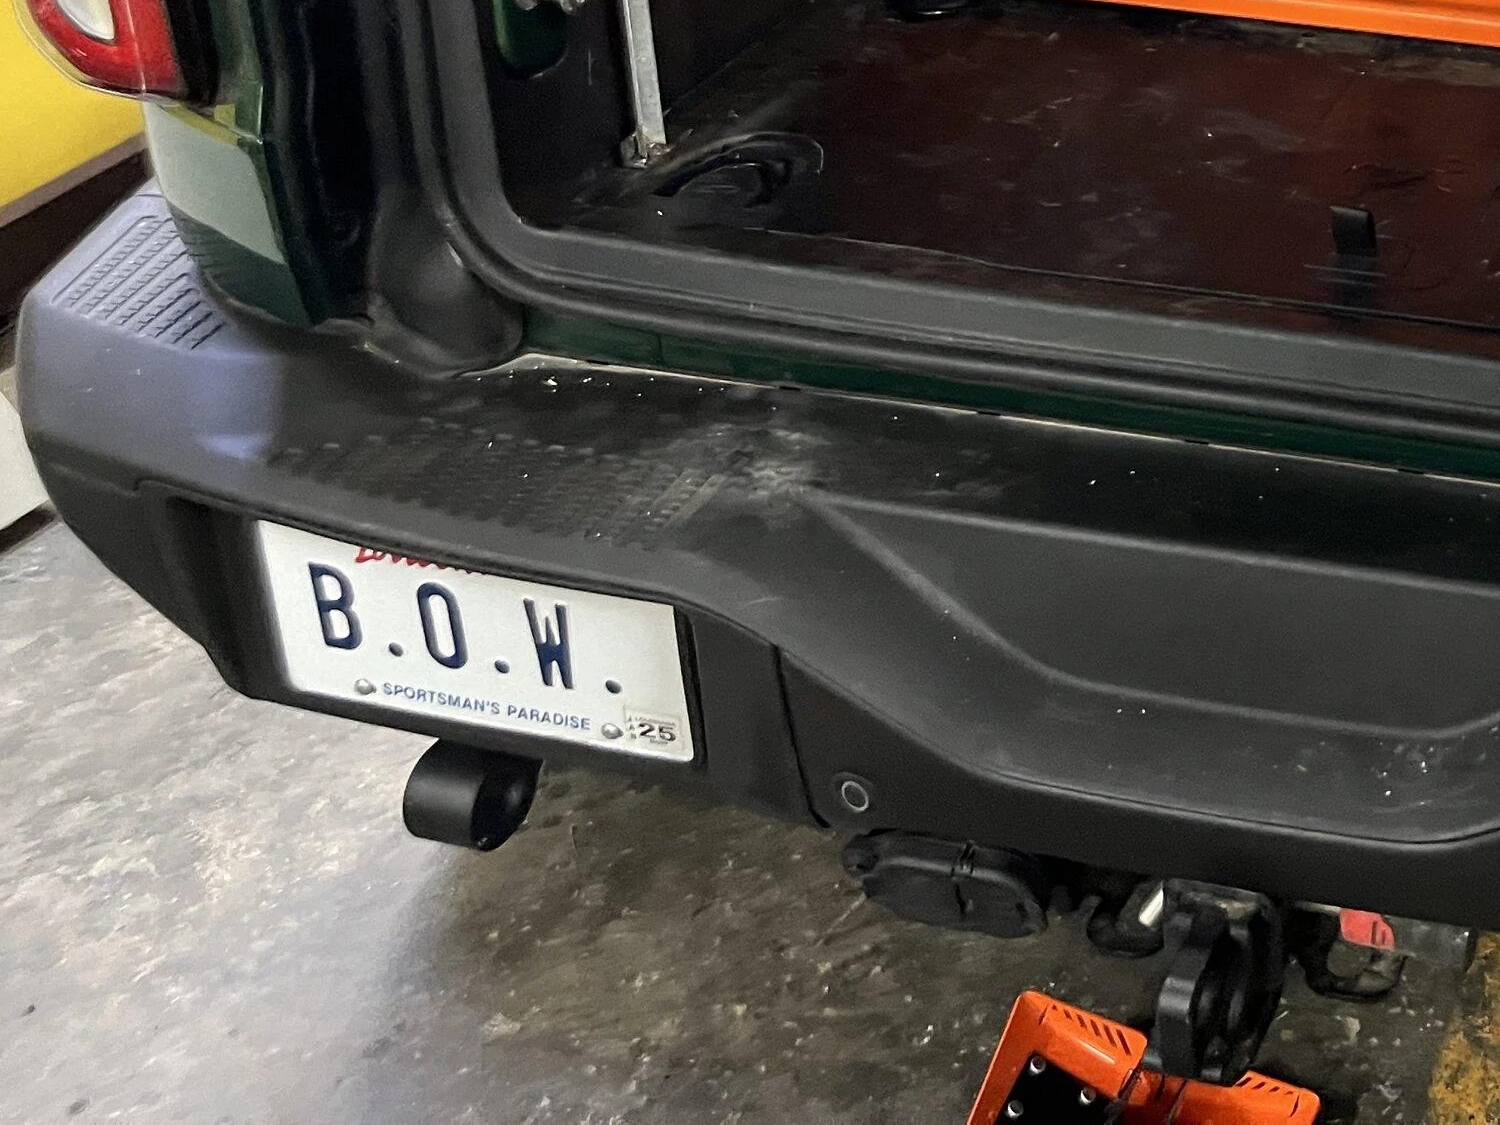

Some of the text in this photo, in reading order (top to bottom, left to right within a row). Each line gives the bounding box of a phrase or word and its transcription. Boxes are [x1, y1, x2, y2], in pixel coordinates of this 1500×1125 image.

[383, 681, 500, 715] SPORTSMAN'S
[507, 704, 591, 731] PARADISE
[638, 722, 677, 742] 25
